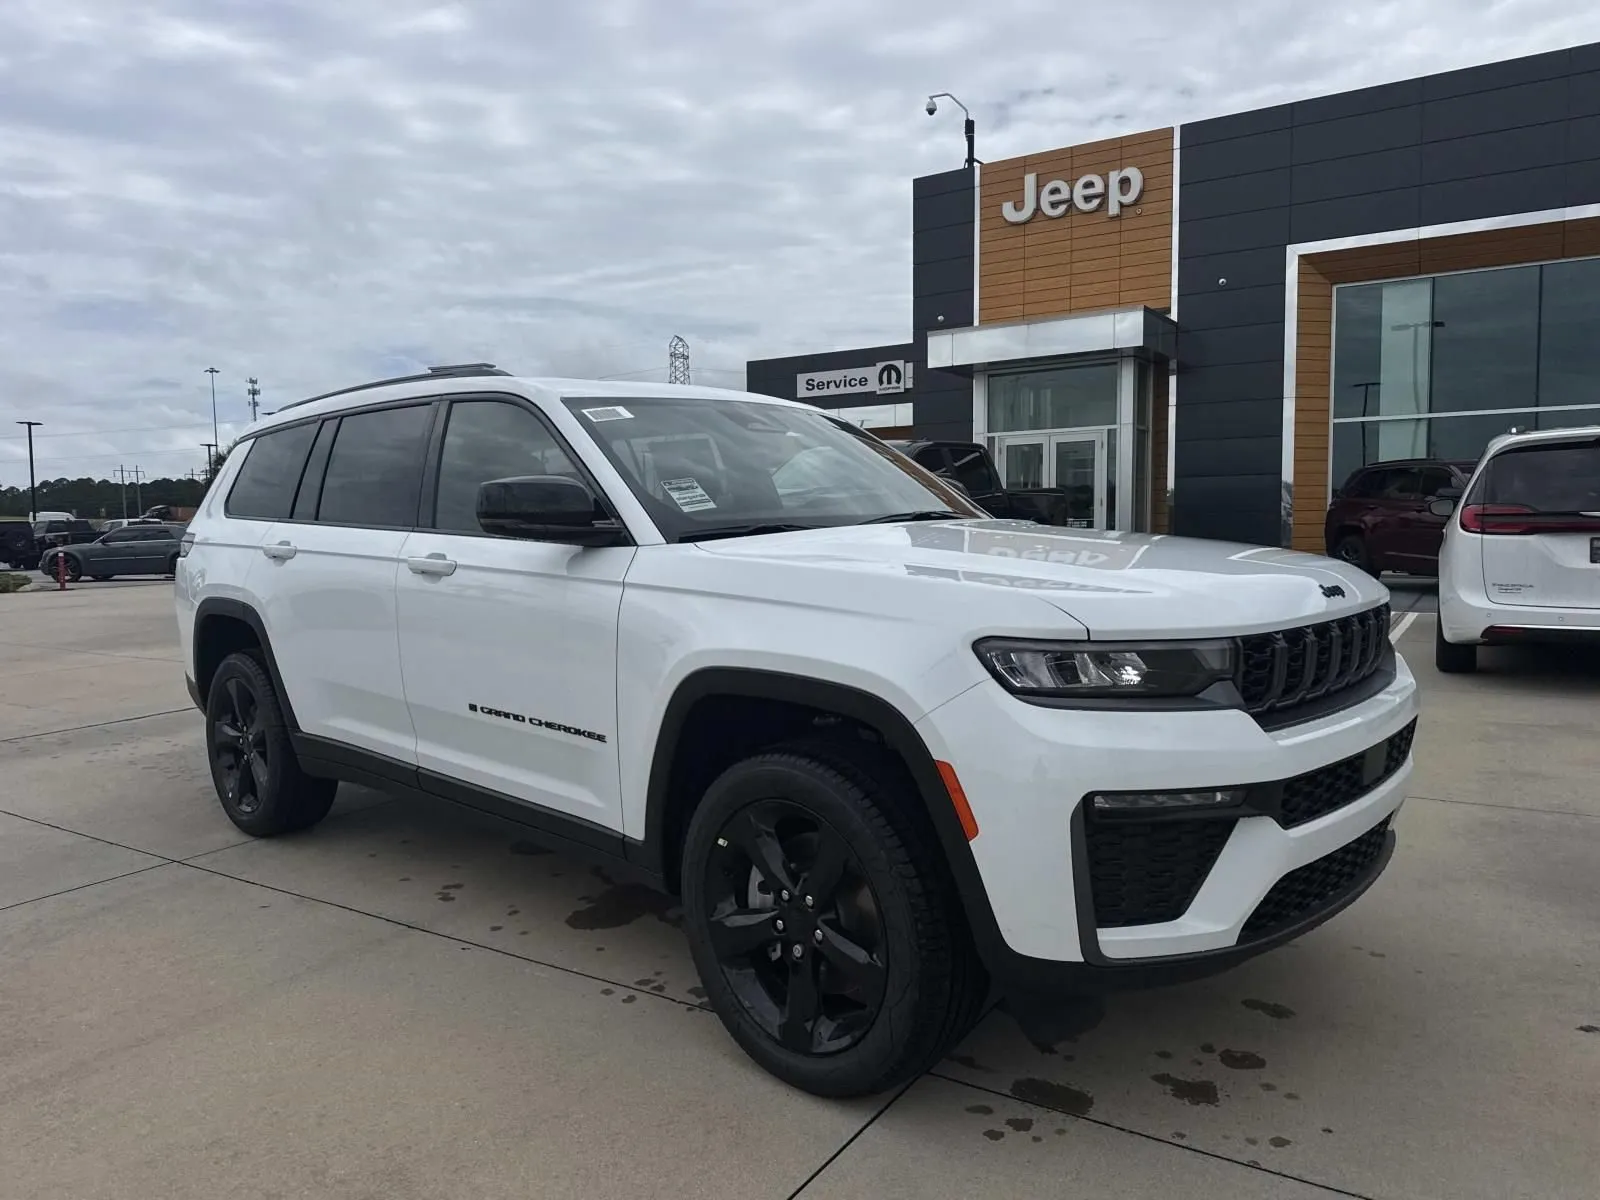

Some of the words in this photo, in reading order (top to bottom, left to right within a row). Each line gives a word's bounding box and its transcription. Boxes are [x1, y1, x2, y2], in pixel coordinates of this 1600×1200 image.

[1002, 167, 1144, 224] Jeep
[805, 376, 868, 391] Service
[480, 706, 526, 723] GRAND
[528, 717, 607, 743] CHEROKEE
